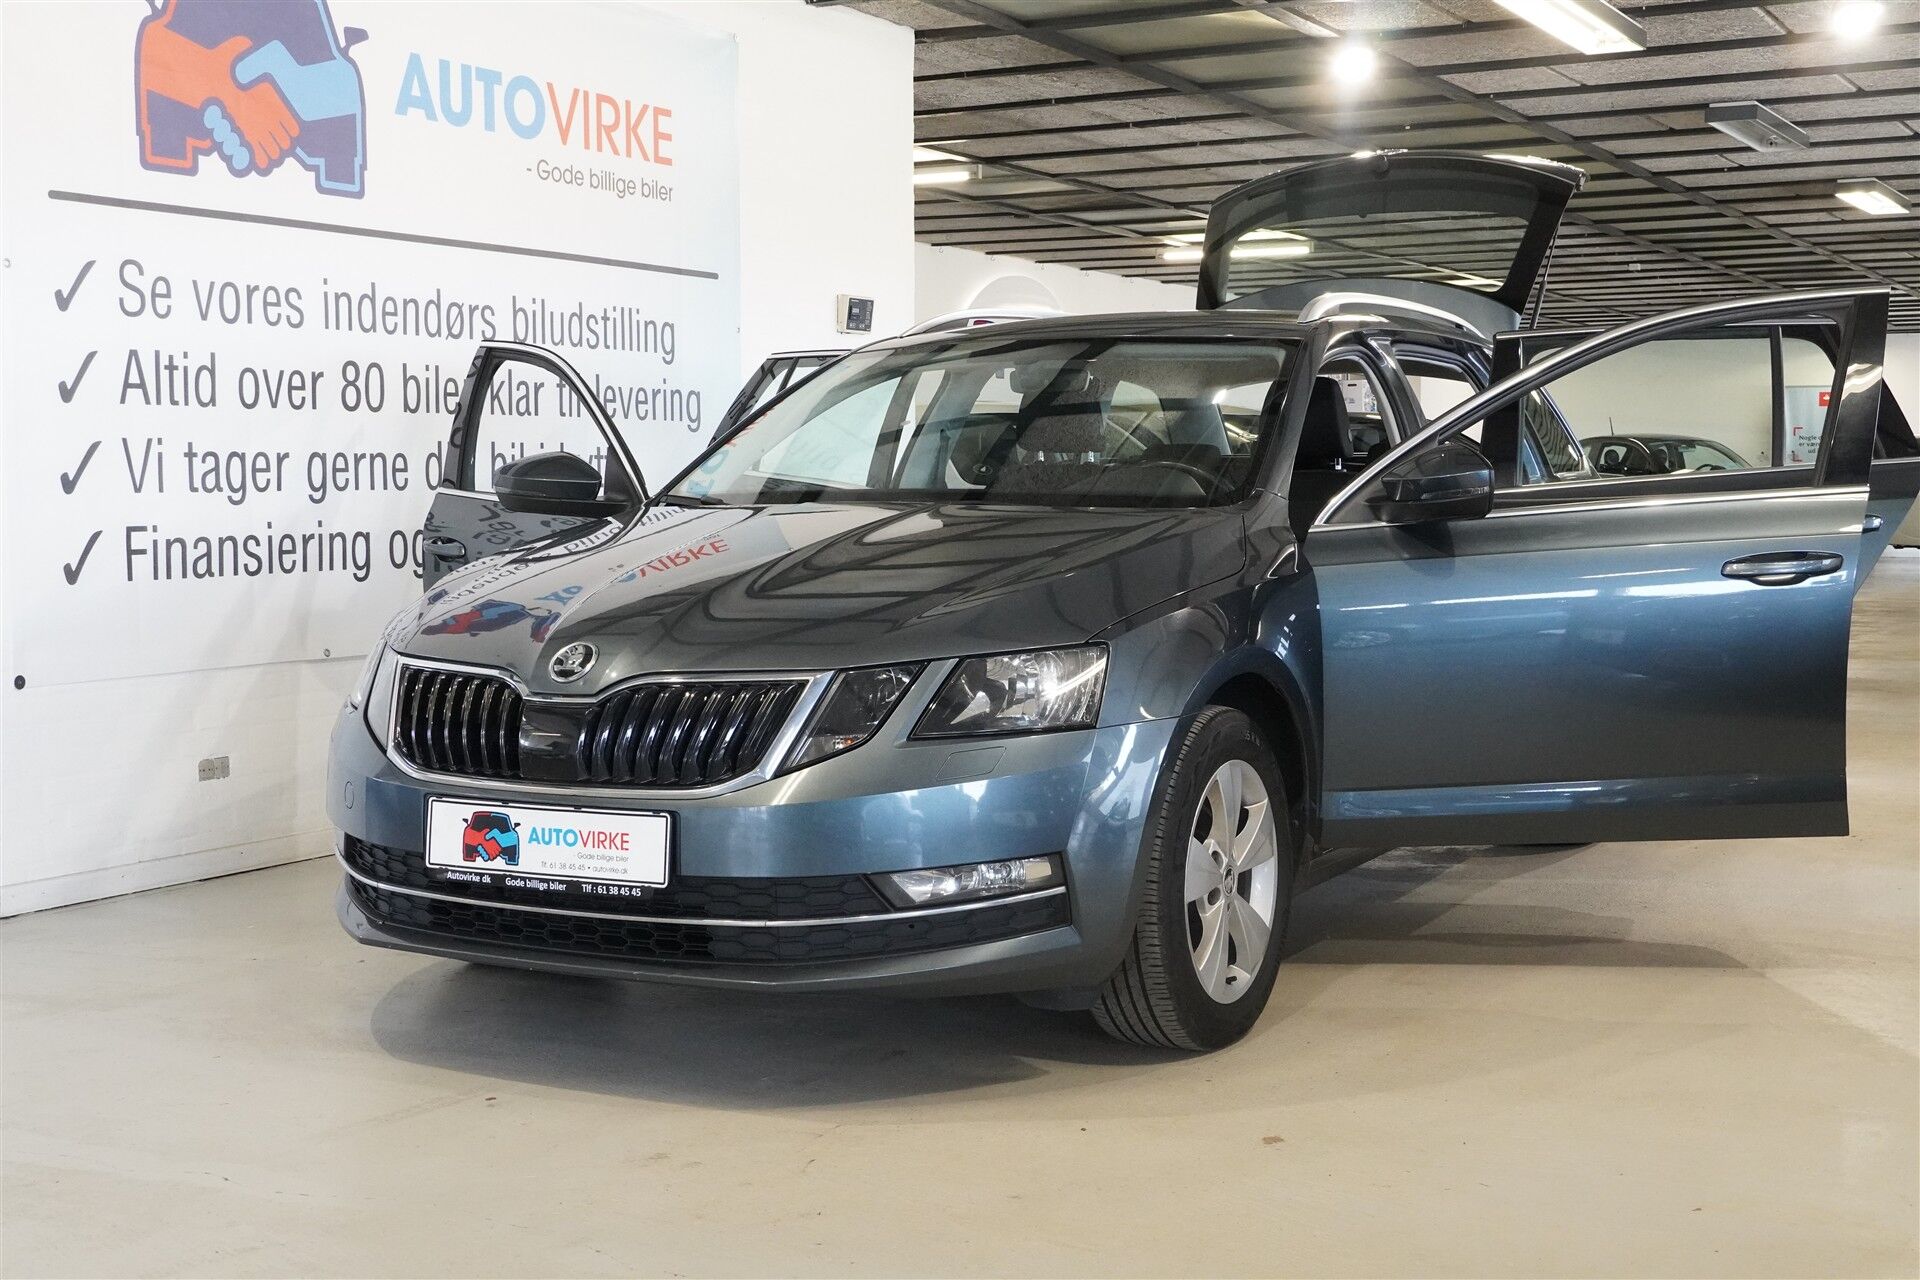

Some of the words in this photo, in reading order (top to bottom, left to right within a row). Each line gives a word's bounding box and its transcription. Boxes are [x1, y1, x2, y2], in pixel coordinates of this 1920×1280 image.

[395, 51, 673, 167] AUTOVIRKE
[536, 159, 585, 187] Gode
[589, 168, 636, 199] billige
[641, 177, 673, 202] biler
[118, 258, 172, 319] Se
[192, 279, 305, 329] vores
[323, 277, 497, 341] indendørs
[512, 295, 676, 366] biludstilling
[119, 349, 217, 408] Altid
[238, 366, 324, 411] over
[340, 360, 385, 413] 80
[402, 362, 462, 415] bile
[490, 368, 544, 417] klar
[595, 374, 702, 433] levering
[121, 437, 164, 494] Vi
[183, 441, 290, 506] tager
[307, 451, 409, 504] gerne
[125, 520, 371, 583] Finansiering
[527, 826, 630, 851] AUTOVIRKE
[446, 871, 481, 883] Autovirke
[482, 874, 492, 884] dk
[505, 877, 525, 888] Gode
[525, 878, 549, 891] billige
[549, 880, 567, 892] biler
[581, 883, 592, 894] Tlf
[597, 885, 608, 895] 61
[608, 885, 619, 896] 38
[619, 886, 630, 896] 45
[631, 887, 642, 897] 45
